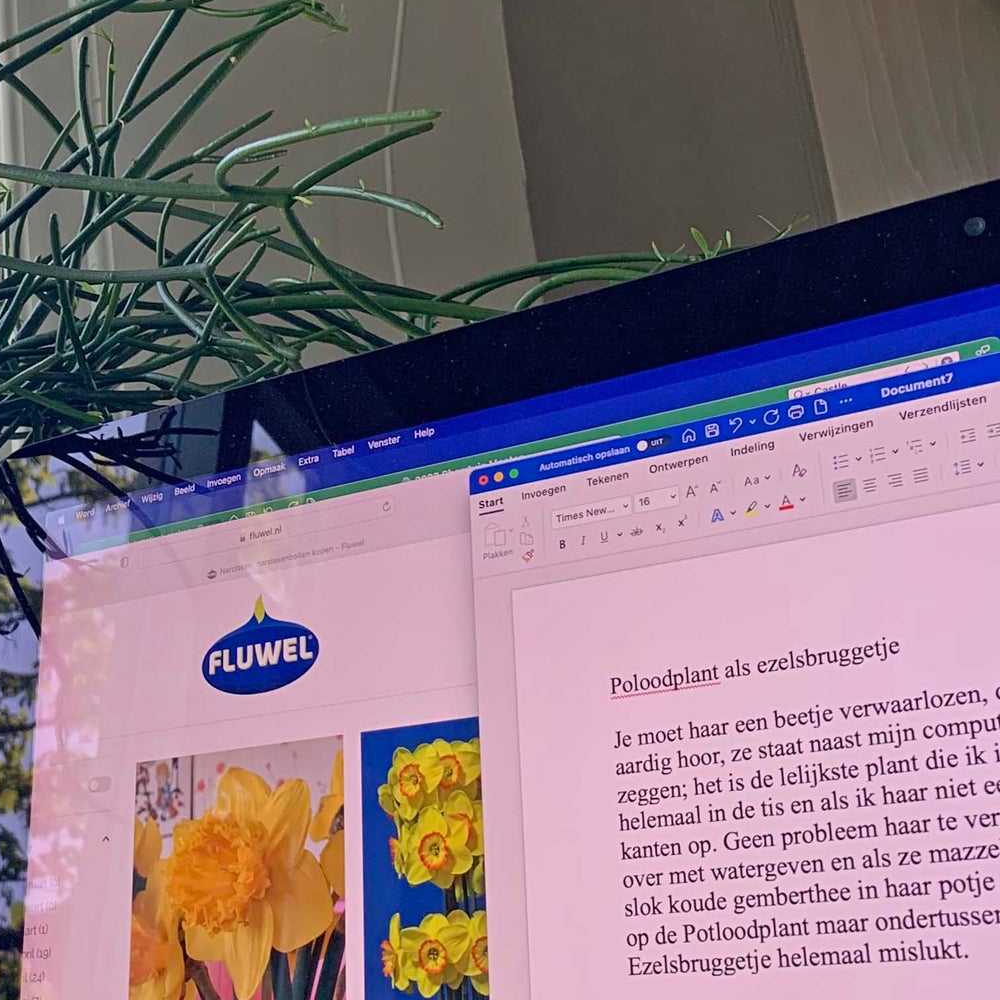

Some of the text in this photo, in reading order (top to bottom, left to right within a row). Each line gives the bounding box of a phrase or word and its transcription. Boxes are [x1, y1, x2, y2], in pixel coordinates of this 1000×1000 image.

[881, 372, 954, 398] Document7
[479, 394, 987, 509] Start Invoegen Tekenen Ontwerpen Indeling Verwijzingen Verzendlijsten
[539, 453, 594, 472] Automatisch
[595, 445, 630, 461] opslaan
[651, 438, 663, 446] UIT
[75, 427, 435, 520] Word Archief Wijzig Beeld Invoegen Opmaak Extra Tabel Venster Help
[556, 511, 584, 524] Times
[638, 497, 650, 507] 16
[250, 526, 282, 540] fluwel.nl
[341, 540, 365, 551] Fluwel
[483, 548, 513, 560] Plakken
[208, 635, 313, 675] FLUWEL
[610, 637, 900, 695] Poloodplant als ezelsbruggetje
[614, 731, 632, 749] Je
[638, 724, 683, 745] moet
[689, 721, 729, 739] haar
[735, 717, 768, 733] een
[773, 704, 833, 728] beetje
[840, 689, 988, 720] verwaarlozen,
[616, 753, 672, 775] aardig
[677, 750, 725, 768] hoor,
[731, 747, 752, 762] ze
[758, 738, 803, 759] staat
[809, 731, 862, 753] naast
[868, 723, 916, 748] mijn
[617, 783, 687, 806] zeggen;
[693, 776, 723, 795] het
[729, 773, 745, 792] is
[751, 770, 773, 789] de
[779, 763, 859, 787] lelijkste
[866, 754, 919, 781] plant
[926, 749, 959, 770] die
[965, 746, 987, 766] ik
[619, 778, 1000, 831] helemaal in de tis en als ik haar niet e
[620, 812, 1000, 860] kanten op. Geen probleem haar te ver
[623, 874, 663, 888] over
[669, 866, 705, 885] met
[710, 858, 825, 881] watergeven
[831, 856, 856, 871] en
[862, 848, 891, 869] als
[898, 850, 922, 866] ze
[625, 871, 995, 917] slok koude gemberthee in haar potje
[626, 931, 649, 950] op
[655, 926, 677, 945] de
[683, 918, 810, 943] Potloodplant
[816, 917, 869, 935] maar
[628, 939, 969, 976] Ezelsbruggetje helemaal mislukt.
